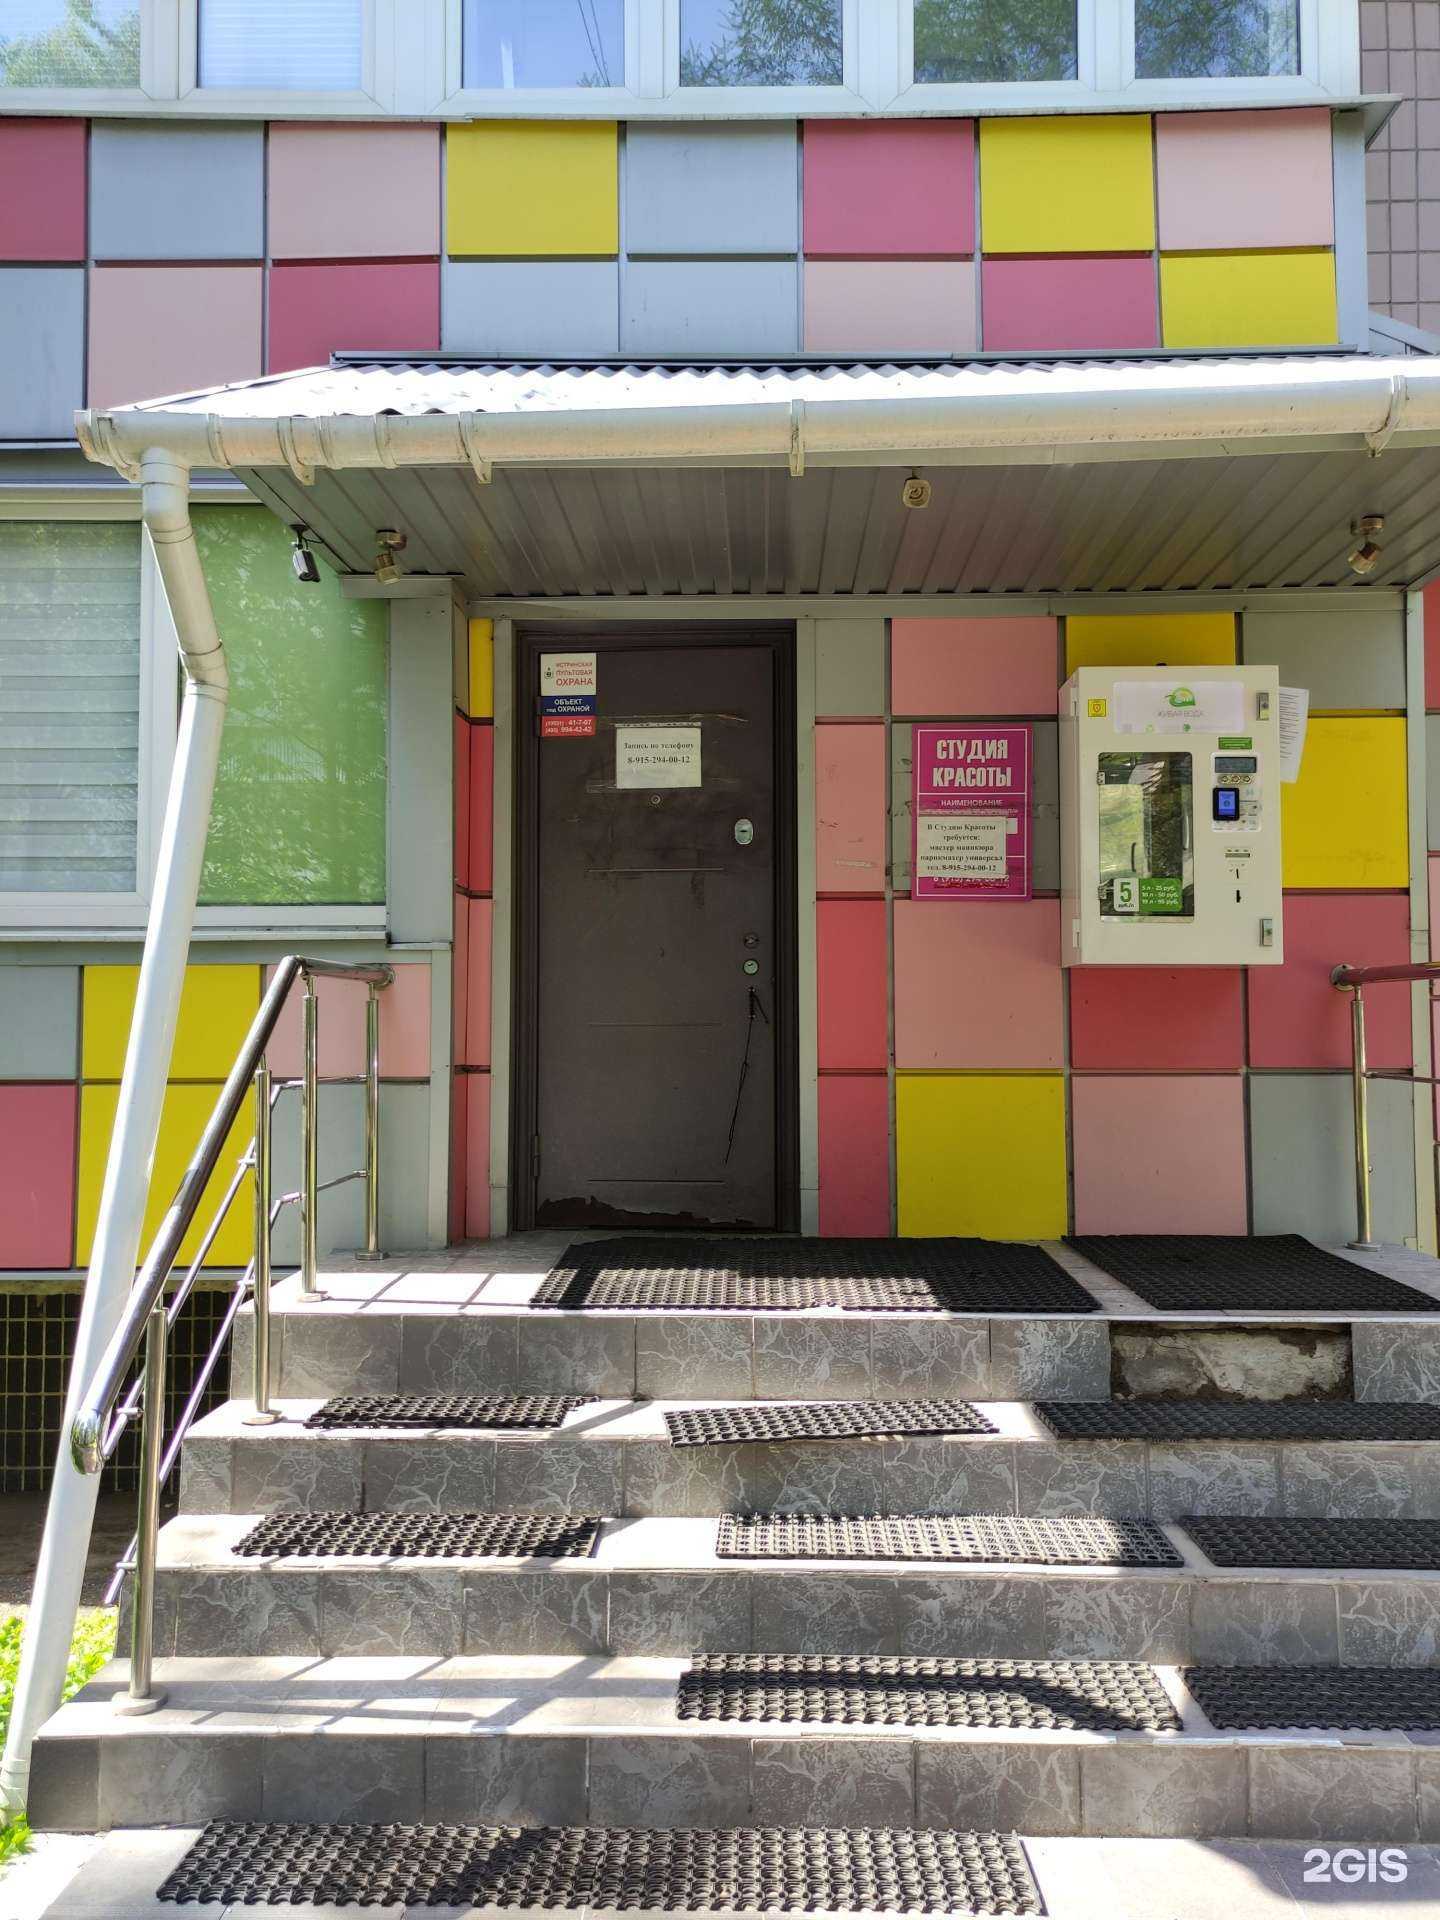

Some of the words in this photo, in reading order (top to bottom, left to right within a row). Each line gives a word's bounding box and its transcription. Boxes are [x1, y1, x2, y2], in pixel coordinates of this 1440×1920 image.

[556, 678, 593, 686] ОХРАНА
[661, 742, 694, 750] телефону
[936, 739, 1009, 763] СТУДИЯ
[627, 755, 691, 764] 8-915-294-00-12
[932, 766, 1012, 787] КРАСОТЫ
[940, 799, 1003, 807] НАИМЕНОВАНИЕ
[934, 824, 962, 832] Студию
[964, 823, 996, 831] Красоты
[942, 864, 996, 872] 8-915-294-00-12
[1119, 881, 1132, 903] 5
